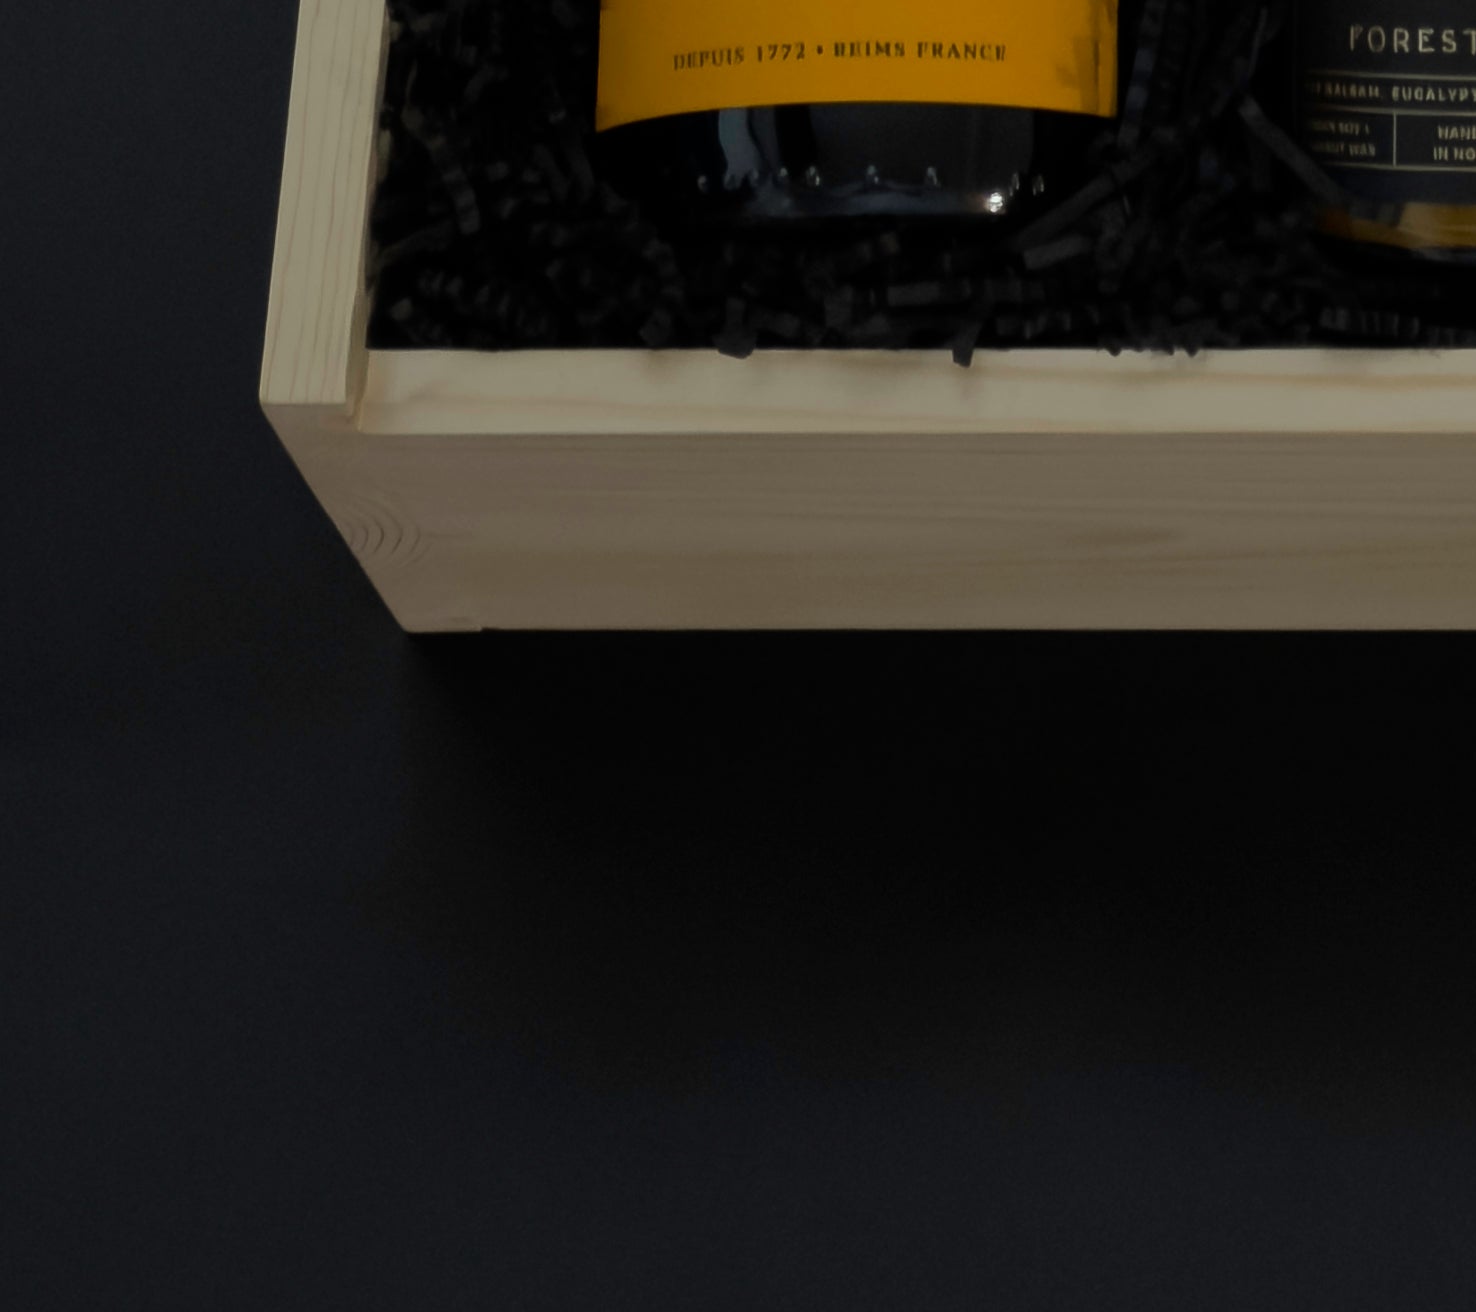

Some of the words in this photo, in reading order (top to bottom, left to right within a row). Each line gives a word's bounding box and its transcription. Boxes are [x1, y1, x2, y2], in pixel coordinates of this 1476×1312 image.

[674, 47, 744, 71] DEPUIS
[757, 43, 806, 62] 1772
[834, 41, 905, 58] REIMS
[918, 42, 1006, 62] FRANCE
[1433, 146, 1448, 161] IN
